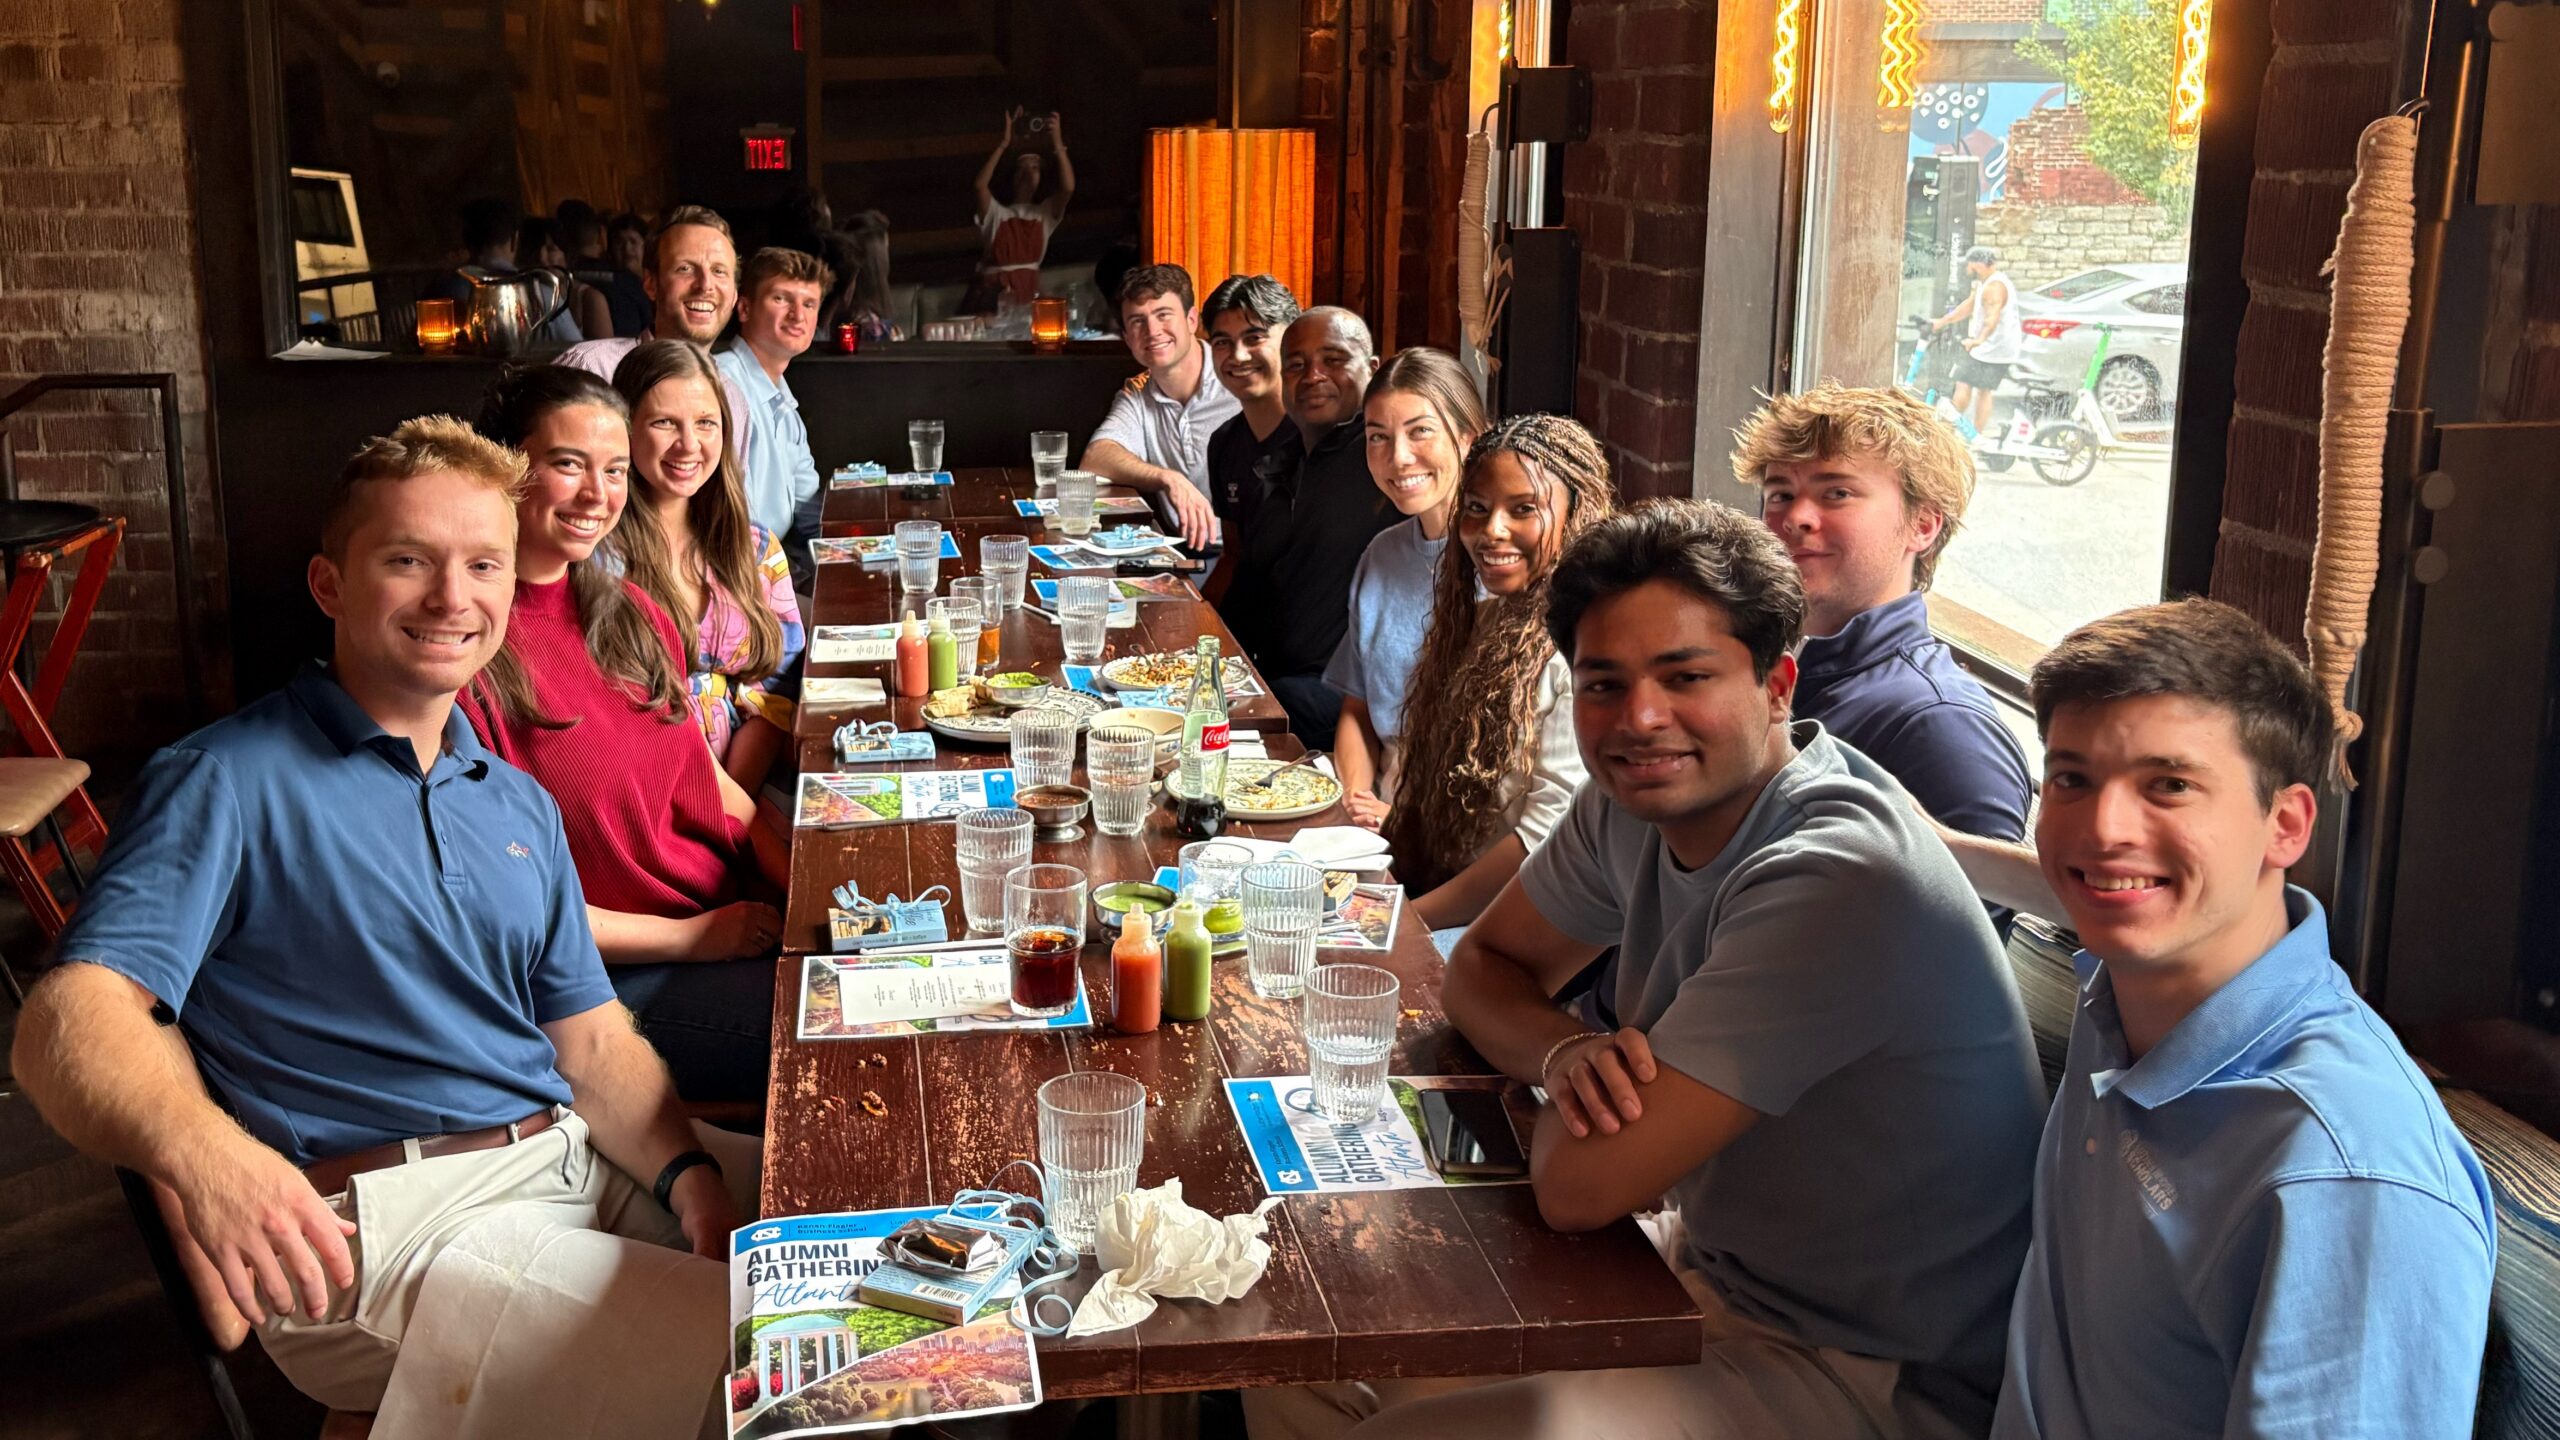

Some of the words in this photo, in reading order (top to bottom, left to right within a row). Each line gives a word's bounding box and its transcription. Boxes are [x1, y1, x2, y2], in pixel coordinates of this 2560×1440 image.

[1303, 1141, 1353, 1184] ALUMNI
[1329, 1123, 1386, 1183] GATHERING
[1373, 1131, 1433, 1181] Atlanta
[746, 1243, 848, 1270] ALUMNI
[747, 1259, 881, 1287] GATHERIN
[746, 1280, 860, 1314] Atlant
